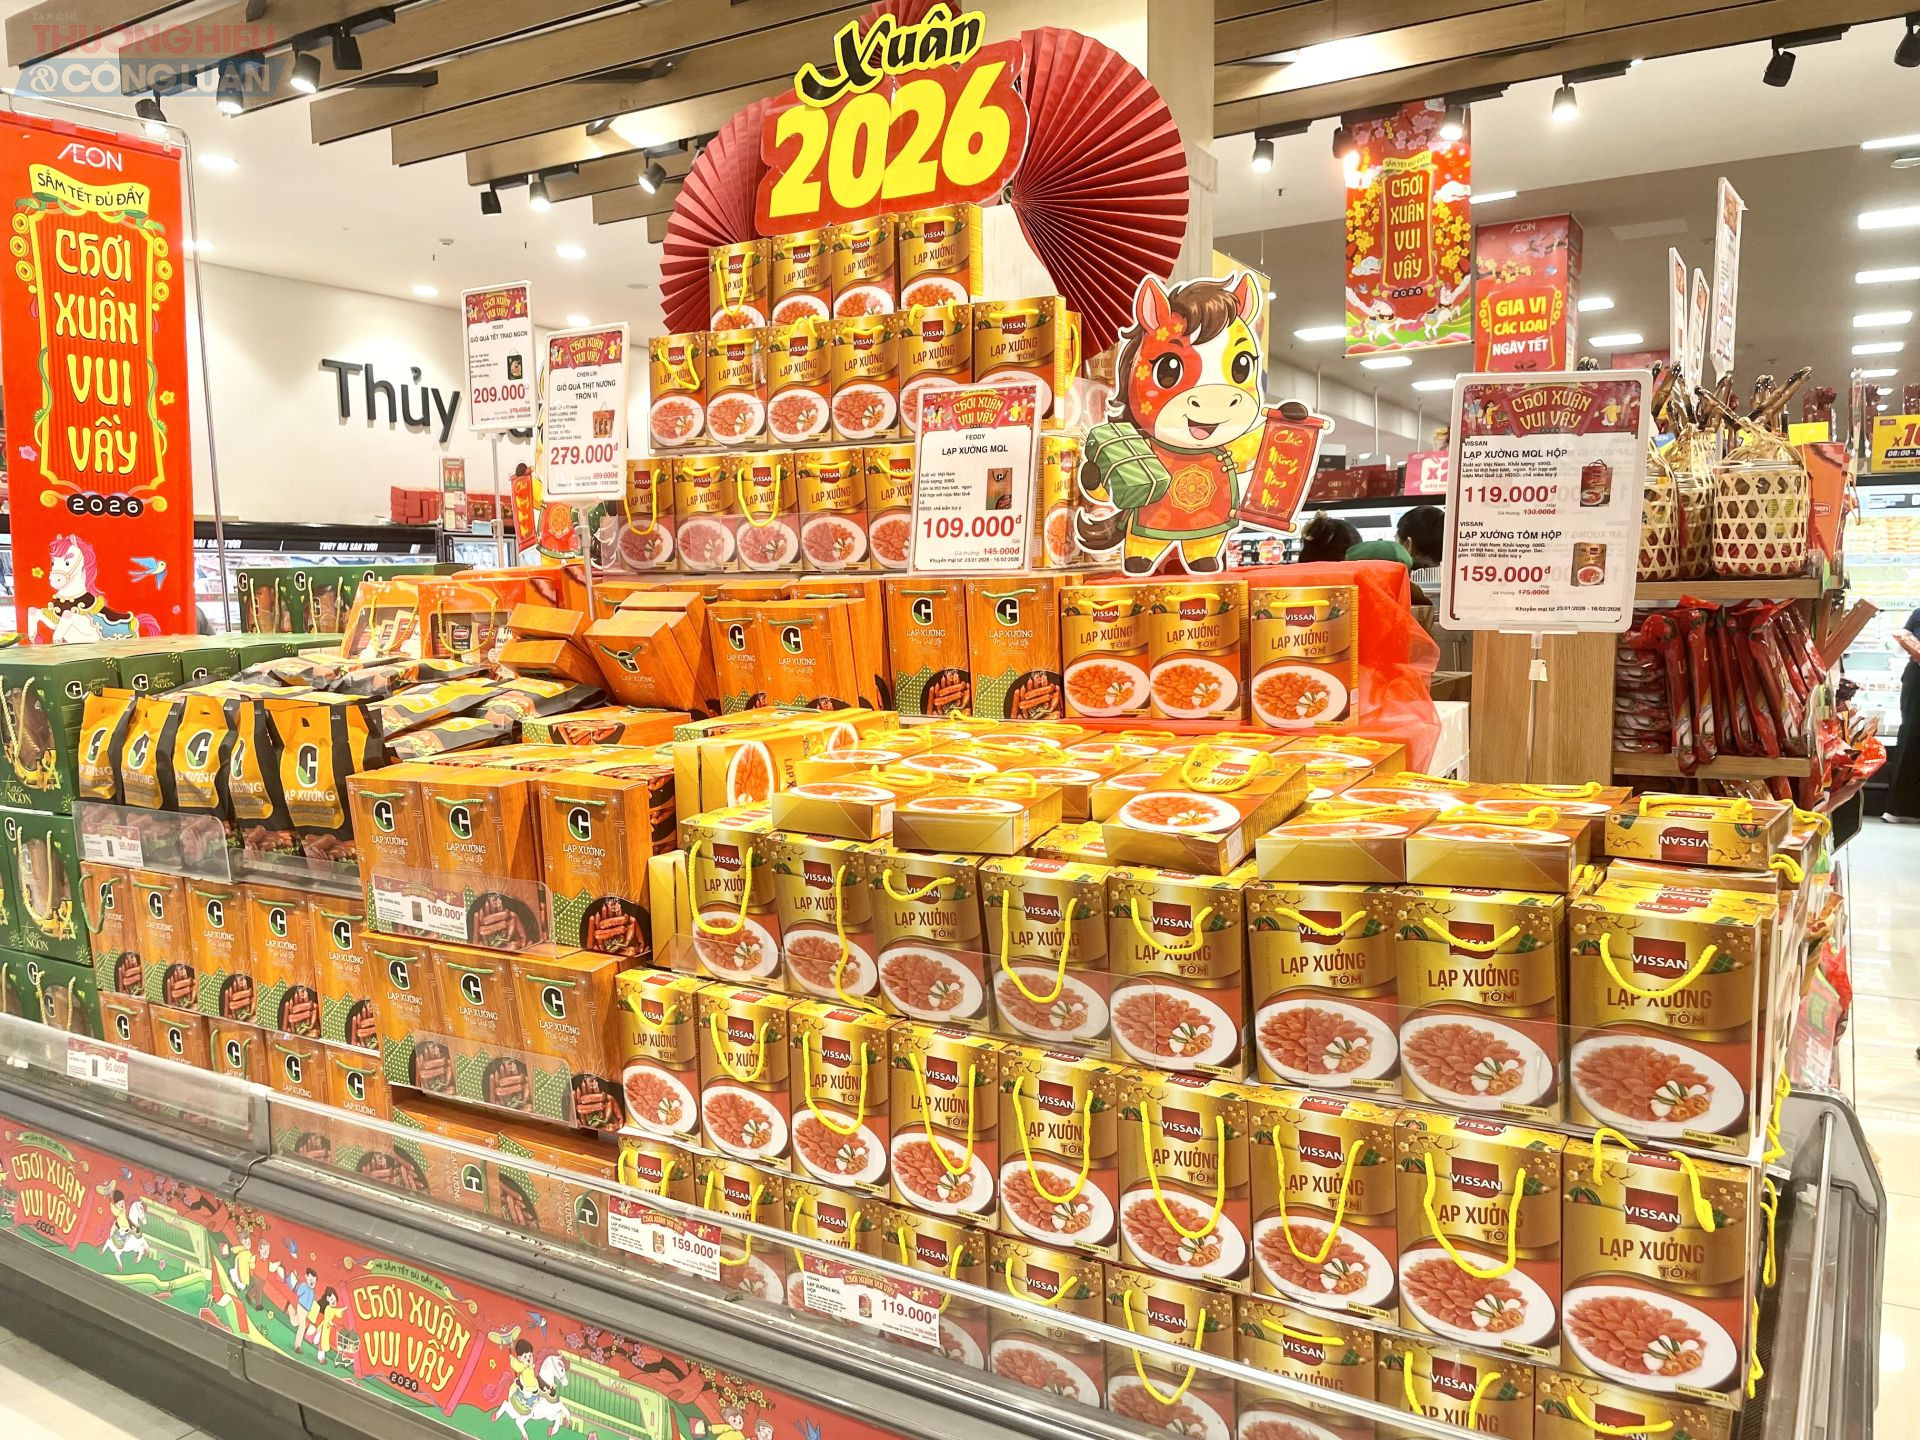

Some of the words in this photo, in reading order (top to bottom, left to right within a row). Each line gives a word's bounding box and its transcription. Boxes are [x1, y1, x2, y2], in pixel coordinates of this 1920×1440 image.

[769, 61, 1011, 218] 2026
[69, 187, 92, 204] TẾT
[96, 191, 114, 207] ĐỦ
[116, 186, 145, 206] ĐẦY
[1390, 200, 1424, 225] XUÂN
[924, 231, 946, 239] VISSAN
[1393, 229, 1421, 251] VUI
[1392, 288, 1423, 298] 2026
[1495, 297, 1527, 317] GIA
[1528, 296, 1547, 316] VỊ
[54, 286, 139, 345] XUÂN
[922, 329, 945, 338] VISSAN
[1001, 321, 1027, 330] VISSAN
[1493, 317, 1518, 336] CÁC
[1519, 315, 1548, 336] LOẠI
[853, 338, 874, 346] VISSAN
[1527, 334, 1549, 352] TẾT
[67, 353, 132, 407] VUI
[319, 357, 460, 444] Thủy
[1551, 389, 1593, 413] XUÂN
[1519, 414, 1546, 430] VUI
[965, 433, 985, 441] FEDDY
[941, 446, 957, 457] LẠP
[958, 443, 989, 456] XƯỞNG
[989, 443, 1009, 453] MQL
[1463, 450, 1482, 460] LẠP
[1484, 448, 1519, 459] XƯỞNG
[1521, 449, 1543, 459] MQL
[1546, 447, 1568, 459] HỘP
[752, 475, 773, 483] VISSAN
[819, 471, 840, 480] VISSAN
[72, 497, 140, 514] 2026
[1459, 531, 1477, 543] LẠP
[1479, 530, 1515, 541] XƯỞNG
[1517, 529, 1541, 540] TÔM
[1543, 530, 1563, 541] HỘP
[1091, 610, 1121, 618] VISSAN
[1179, 608, 1209, 617] VISSAN
[1284, 613, 1317, 623] VISSAN
[1659, 834, 1711, 849] VISSAN
[562, 843, 579, 855] LẠP
[578, 844, 606, 857] XƯỞNG
[712, 854, 742, 866] VISSAN
[703, 878, 722, 893] LẠP
[803, 872, 834, 884] VISSAN
[794, 896, 813, 911] LẠP
[1023, 905, 1062, 918] VISSAN
[894, 911, 915, 927] LẠP
[918, 907, 958, 927] XƯỞNG
[1152, 917, 1194, 930] VISSAN
[1011, 930, 1034, 947] LẠP
[1178, 962, 1209, 976] TÔM
[1280, 956, 1309, 976] LẠP
[1313, 948, 1366, 972] XƯỞNG
[1632, 953, 1689, 971] VISSAN
[1329, 972, 1363, 986] TÔM
[1427, 968, 1458, 991] LẠP
[1463, 963, 1520, 987] XƯỞNG
[1481, 989, 1517, 1003] TÔM
[1607, 987, 1641, 1010] LẠP
[1666, 1011, 1707, 1026] TÔM
[538, 1019, 555, 1031] LẠP
[554, 1022, 580, 1036] XƯỞNG
[727, 1028, 756, 1041] VISSAN
[632, 1031, 650, 1048] LẠP
[650, 1032, 678, 1049] XƯỞNG
[821, 1048, 853, 1063] VISSAN
[925, 1068, 960, 1085] VISSAN
[1036, 1094, 1076, 1111] VISSAN
[1160, 1120, 1203, 1136] VISSAN
[1453, 1119, 1508, 1133] VISSAN
[1298, 1145, 1345, 1163] VISSAN
[637, 1166, 664, 1178] VISSAN
[46, 1158, 86, 1207] XUÂN
[1450, 1172, 1503, 1191] VISSAN
[723, 1188, 752, 1201] VISSAN
[20, 1189, 44, 1217] VUI
[817, 1213, 848, 1228] VISSAN
[1623, 1203, 1682, 1225] VISSAN
[915, 1245, 950, 1263] VISSAN
[1658, 1266, 1700, 1281] TÔM
[408, 1290, 471, 1359] XUÂN
[1146, 1308, 1188, 1328] VISSAN
[364, 1330, 401, 1368] VUI
[1282, 1339, 1326, 1361] VISSAN
[390, 1371, 418, 1392] 2026
[1430, 1371, 1478, 1393] VISSAN
